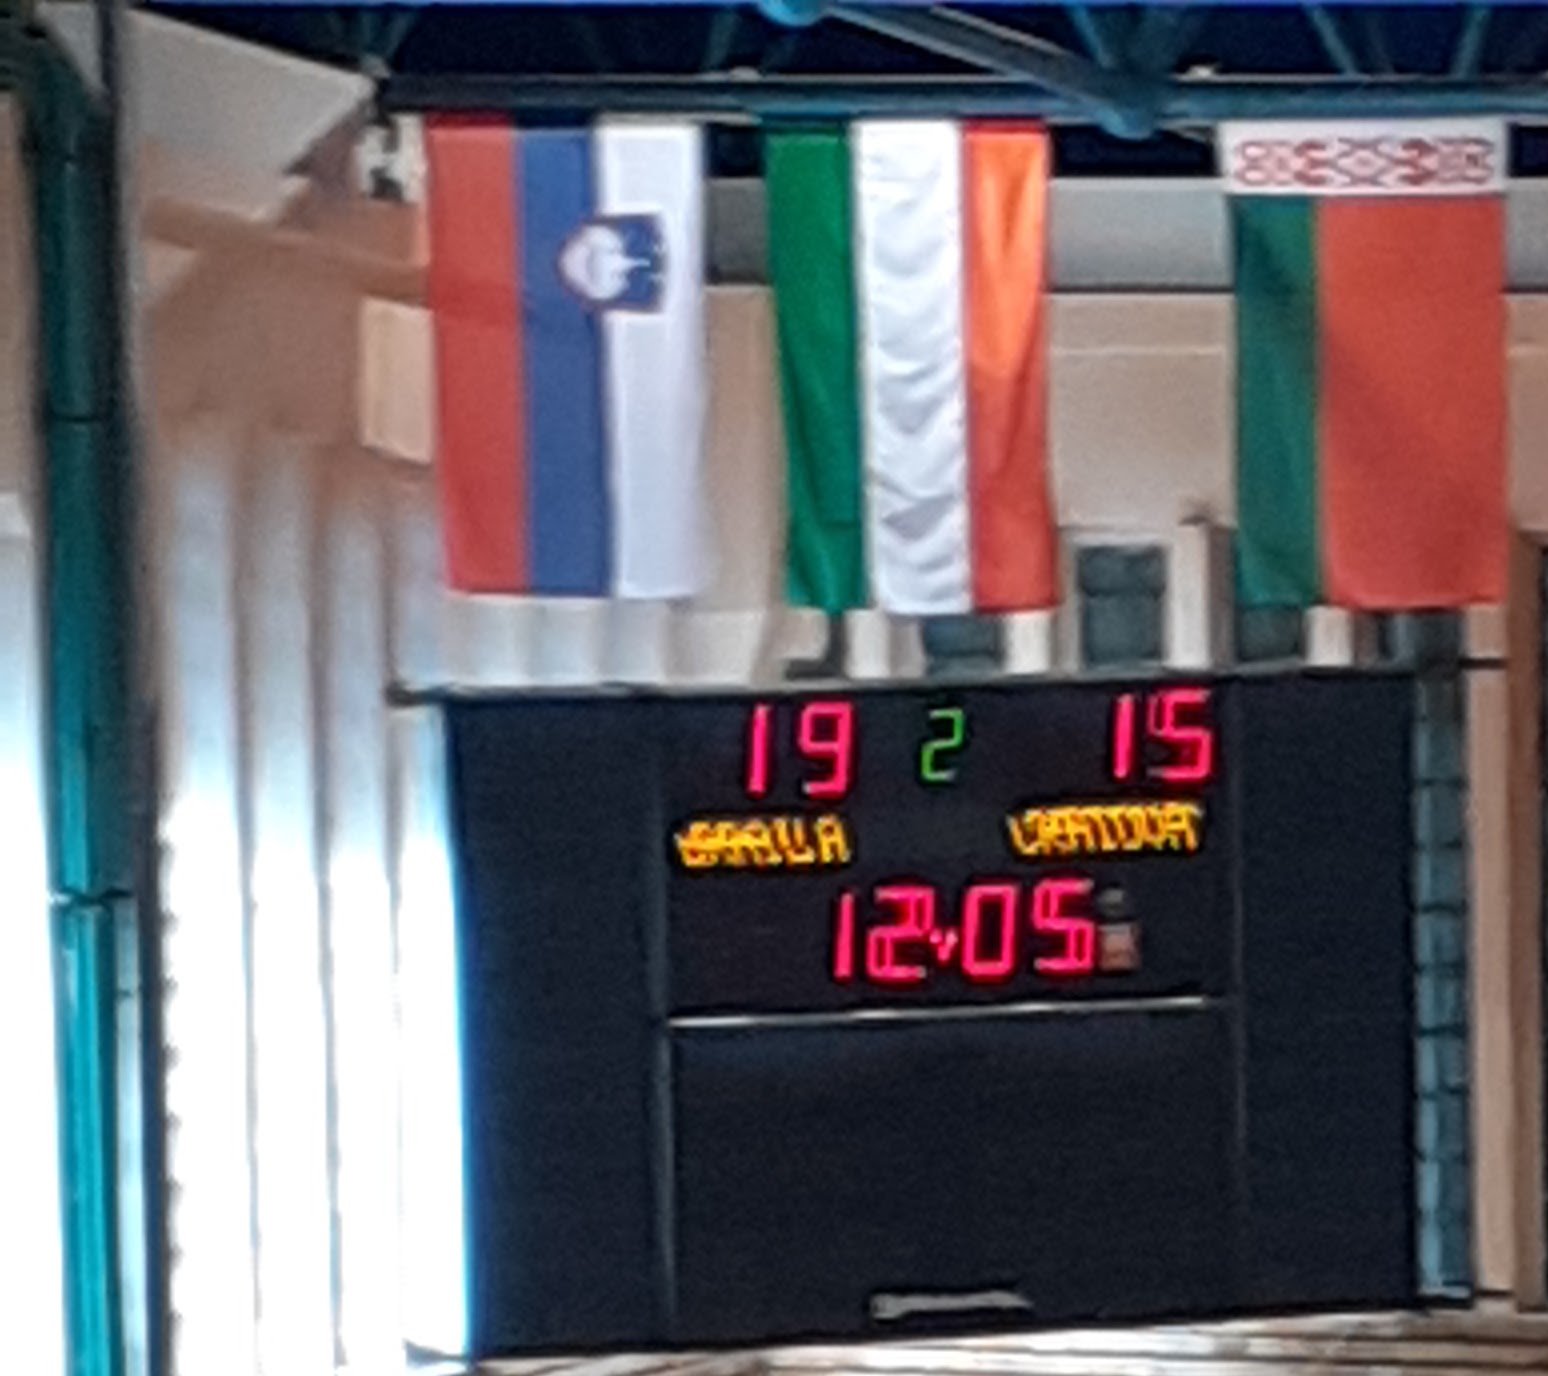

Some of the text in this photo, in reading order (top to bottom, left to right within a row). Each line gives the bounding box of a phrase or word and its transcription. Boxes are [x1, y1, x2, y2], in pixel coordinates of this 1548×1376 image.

[745, 700, 854, 794] 19
[919, 707, 966, 782] 2
[1111, 687, 1213, 780] 15
